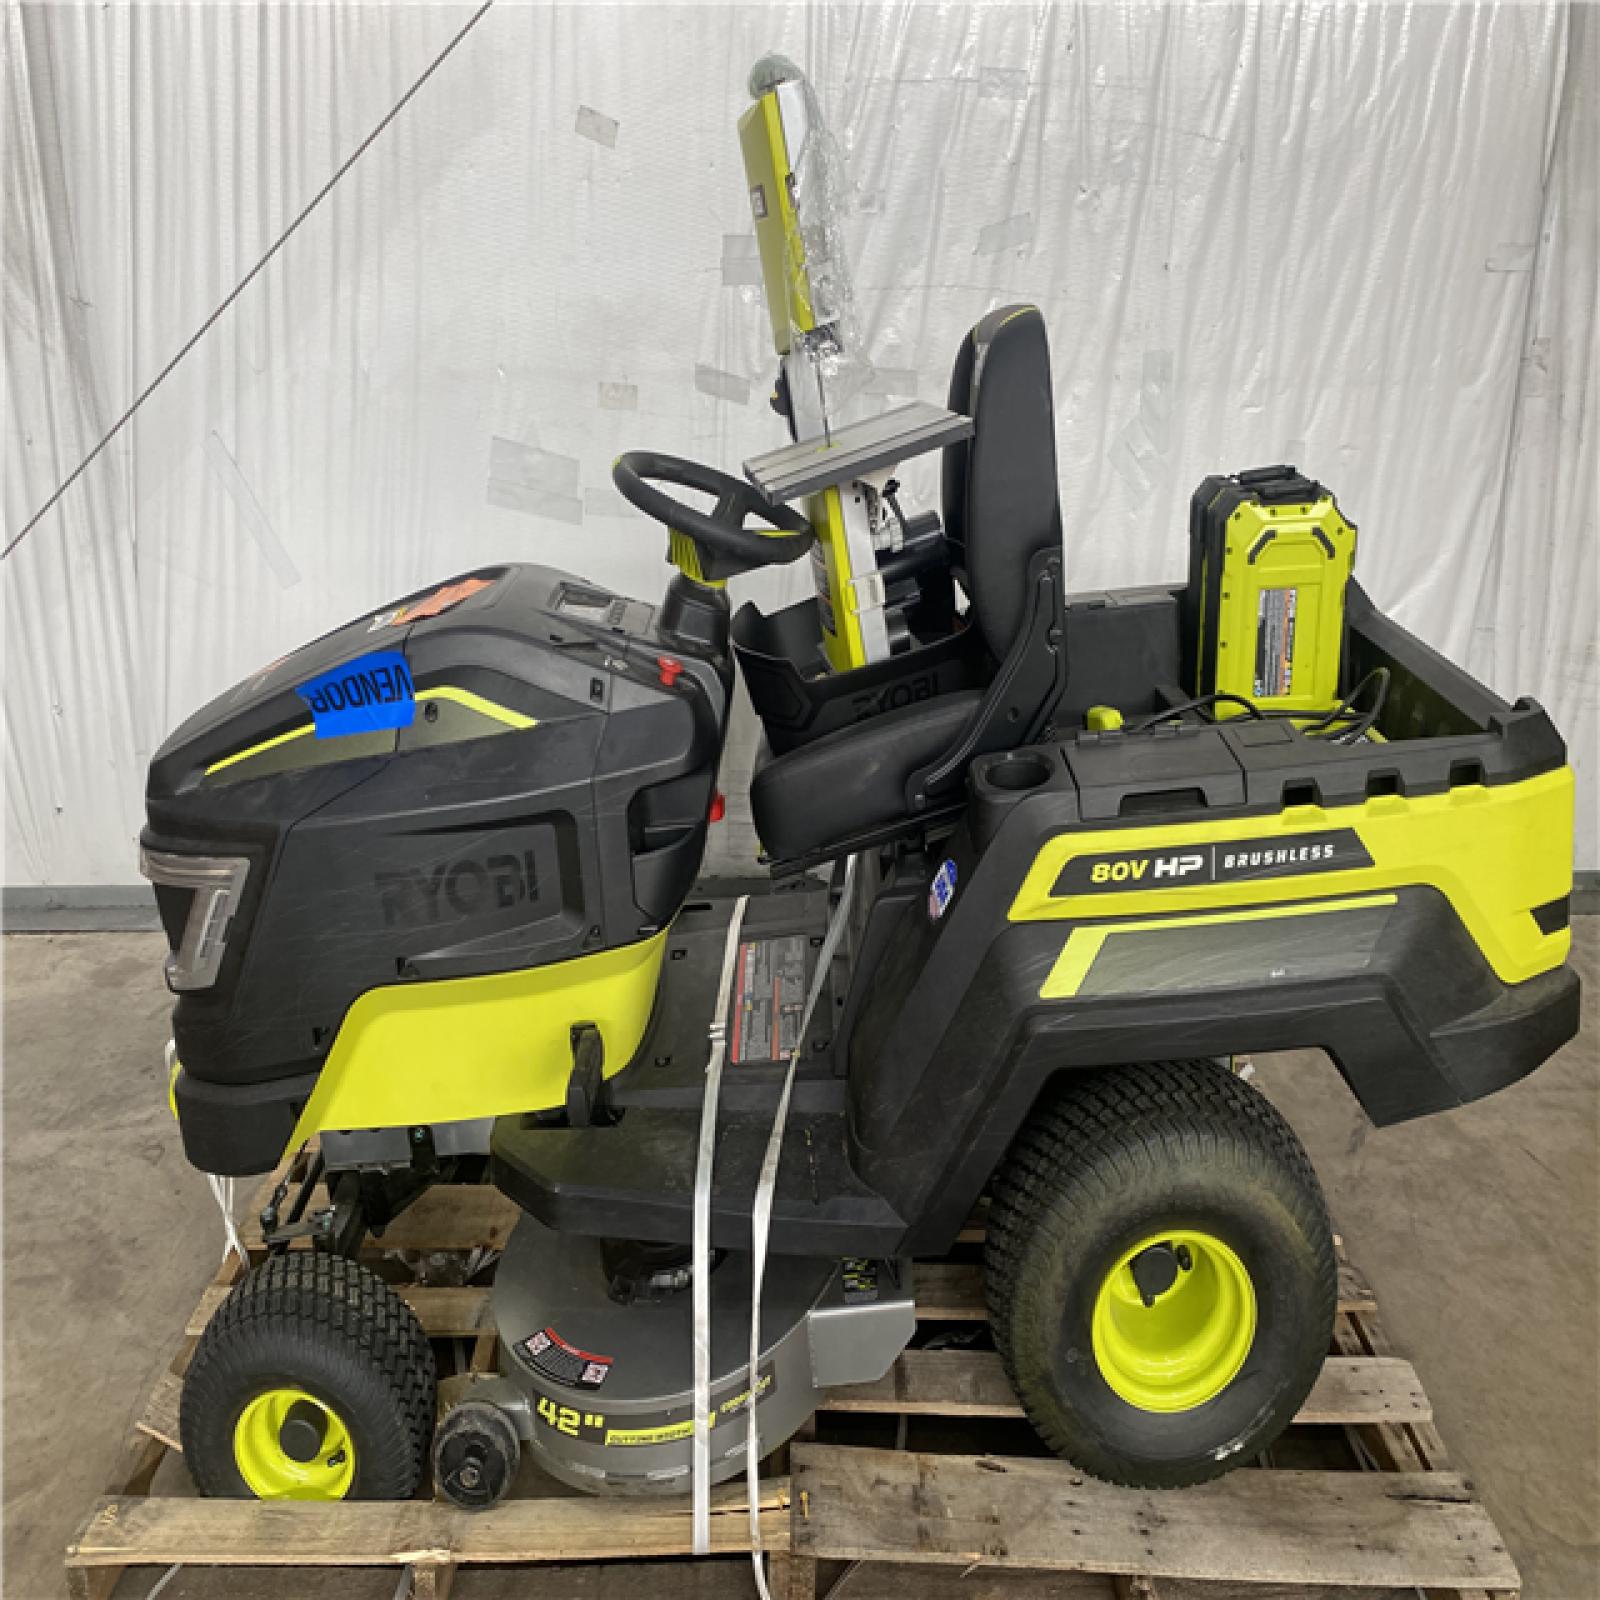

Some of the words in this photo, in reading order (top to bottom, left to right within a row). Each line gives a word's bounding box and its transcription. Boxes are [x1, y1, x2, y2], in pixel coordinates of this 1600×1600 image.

[304, 664, 414, 713] VENDOR
[374, 849, 539, 926] RYOBI
[1091, 859, 1148, 883] 80V
[1154, 854, 1204, 878] HP
[1224, 844, 1335, 869] BRUSHLESS
